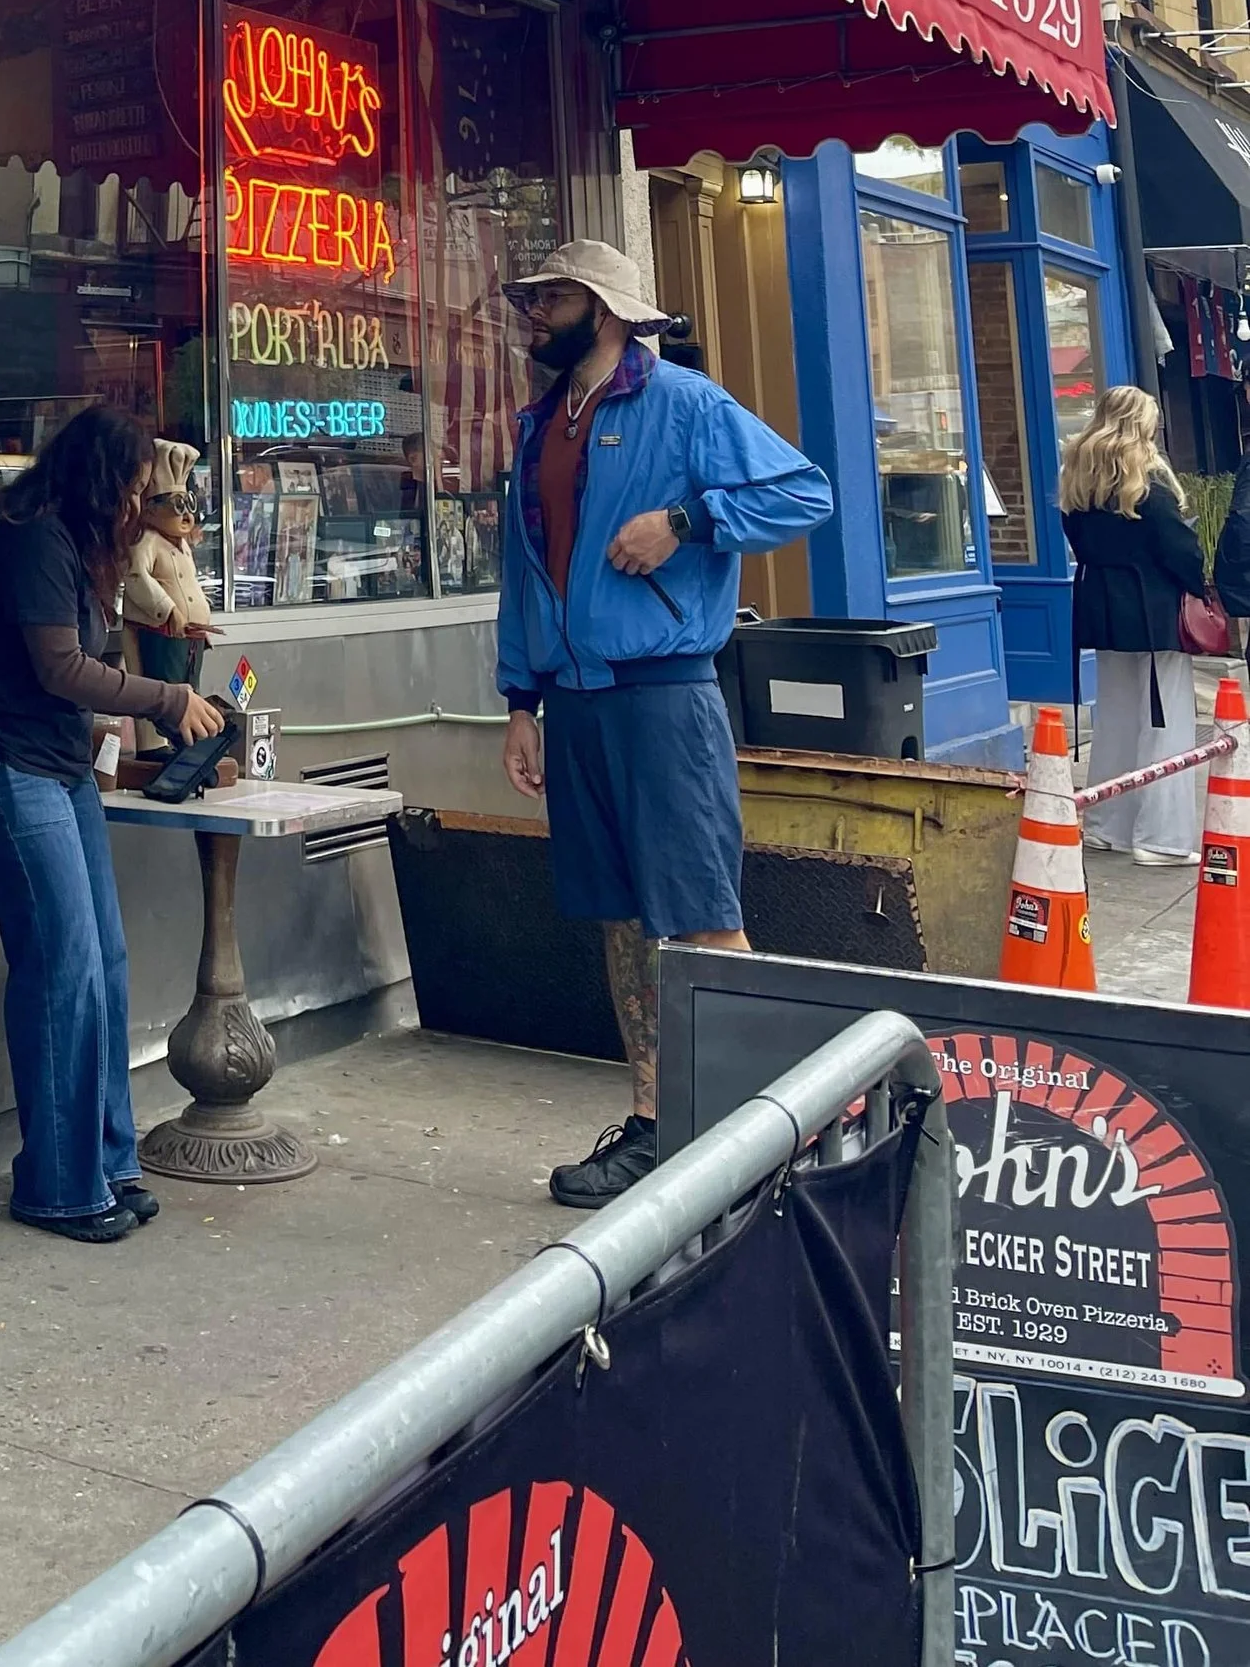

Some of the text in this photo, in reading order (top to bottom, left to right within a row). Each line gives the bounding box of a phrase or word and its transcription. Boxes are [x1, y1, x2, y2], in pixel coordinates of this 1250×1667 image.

[980, 1058, 1091, 1091] Original
[955, 1091, 1162, 1210] ohn's
[965, 1229, 1152, 1289] ECKER STREET
[957, 1312, 1069, 1344] EST. 1929
[965, 1288, 1022, 1314] Brick
[1026, 1297, 1079, 1319] Oven
[1082, 1304, 1169, 1333] Pizzeria
[988, 1351, 1207, 1390] NY, NY 10014 (212) 243 1680
